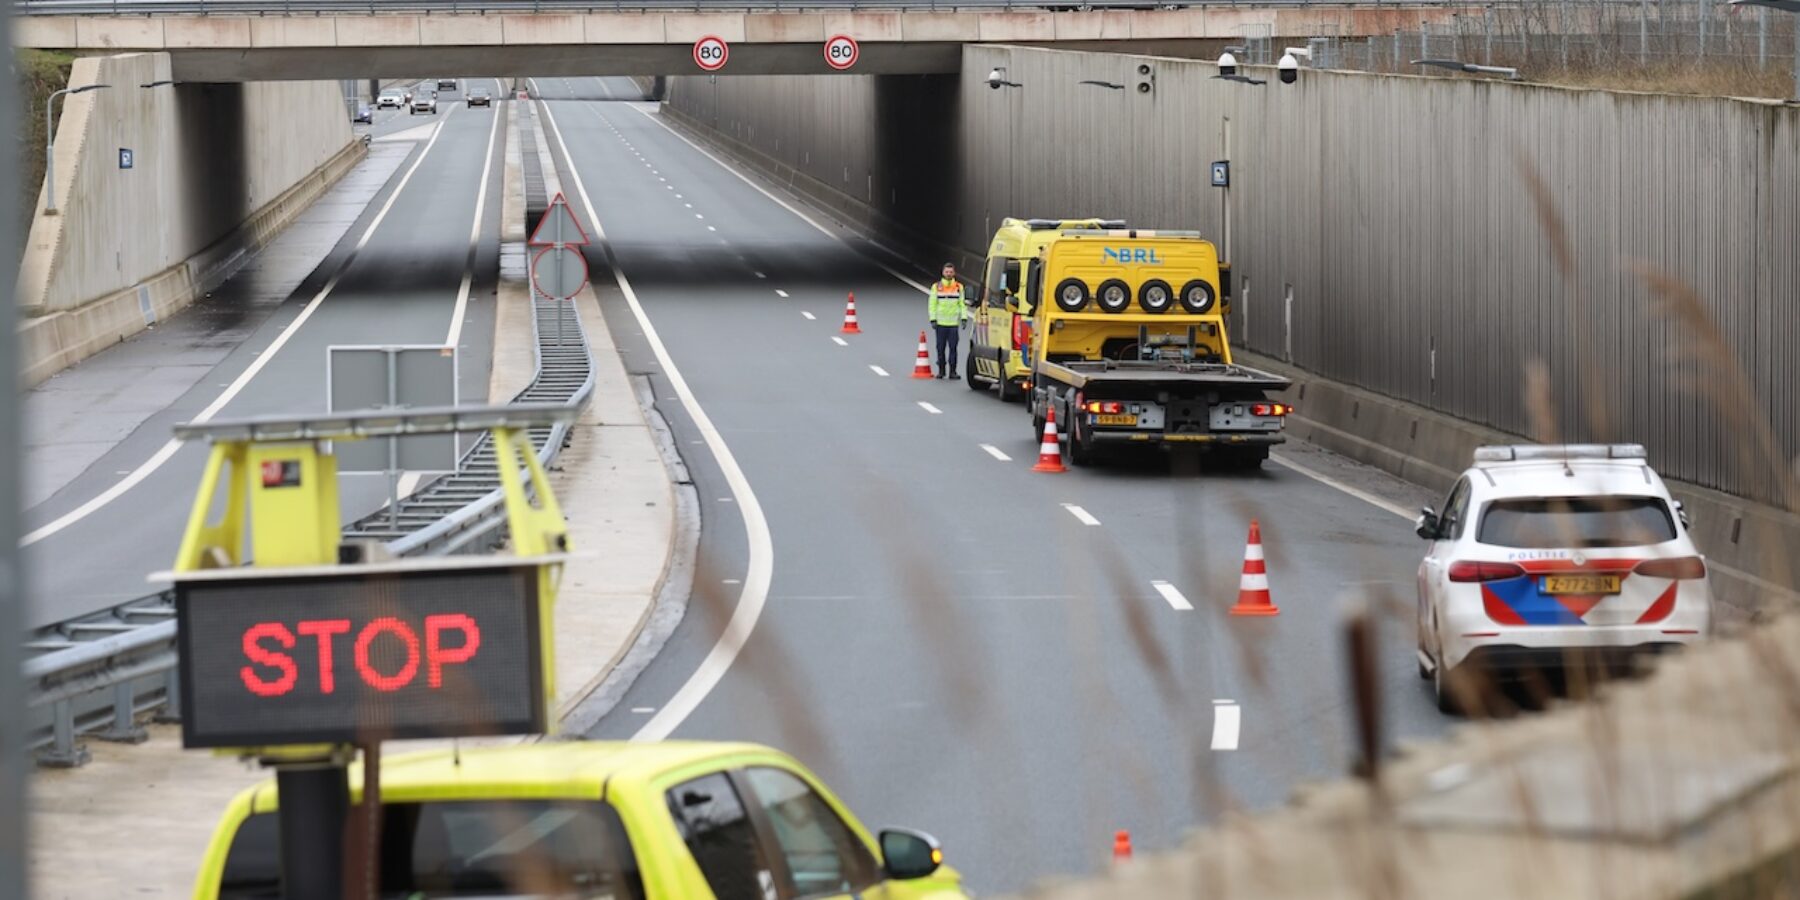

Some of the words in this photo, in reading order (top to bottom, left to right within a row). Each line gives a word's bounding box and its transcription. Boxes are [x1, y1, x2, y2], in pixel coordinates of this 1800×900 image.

[700, 46, 722, 59] 80
[830, 45, 852, 58] 80
[1508, 551, 1567, 560] POLITIE
[240, 614, 480, 696] STOP
